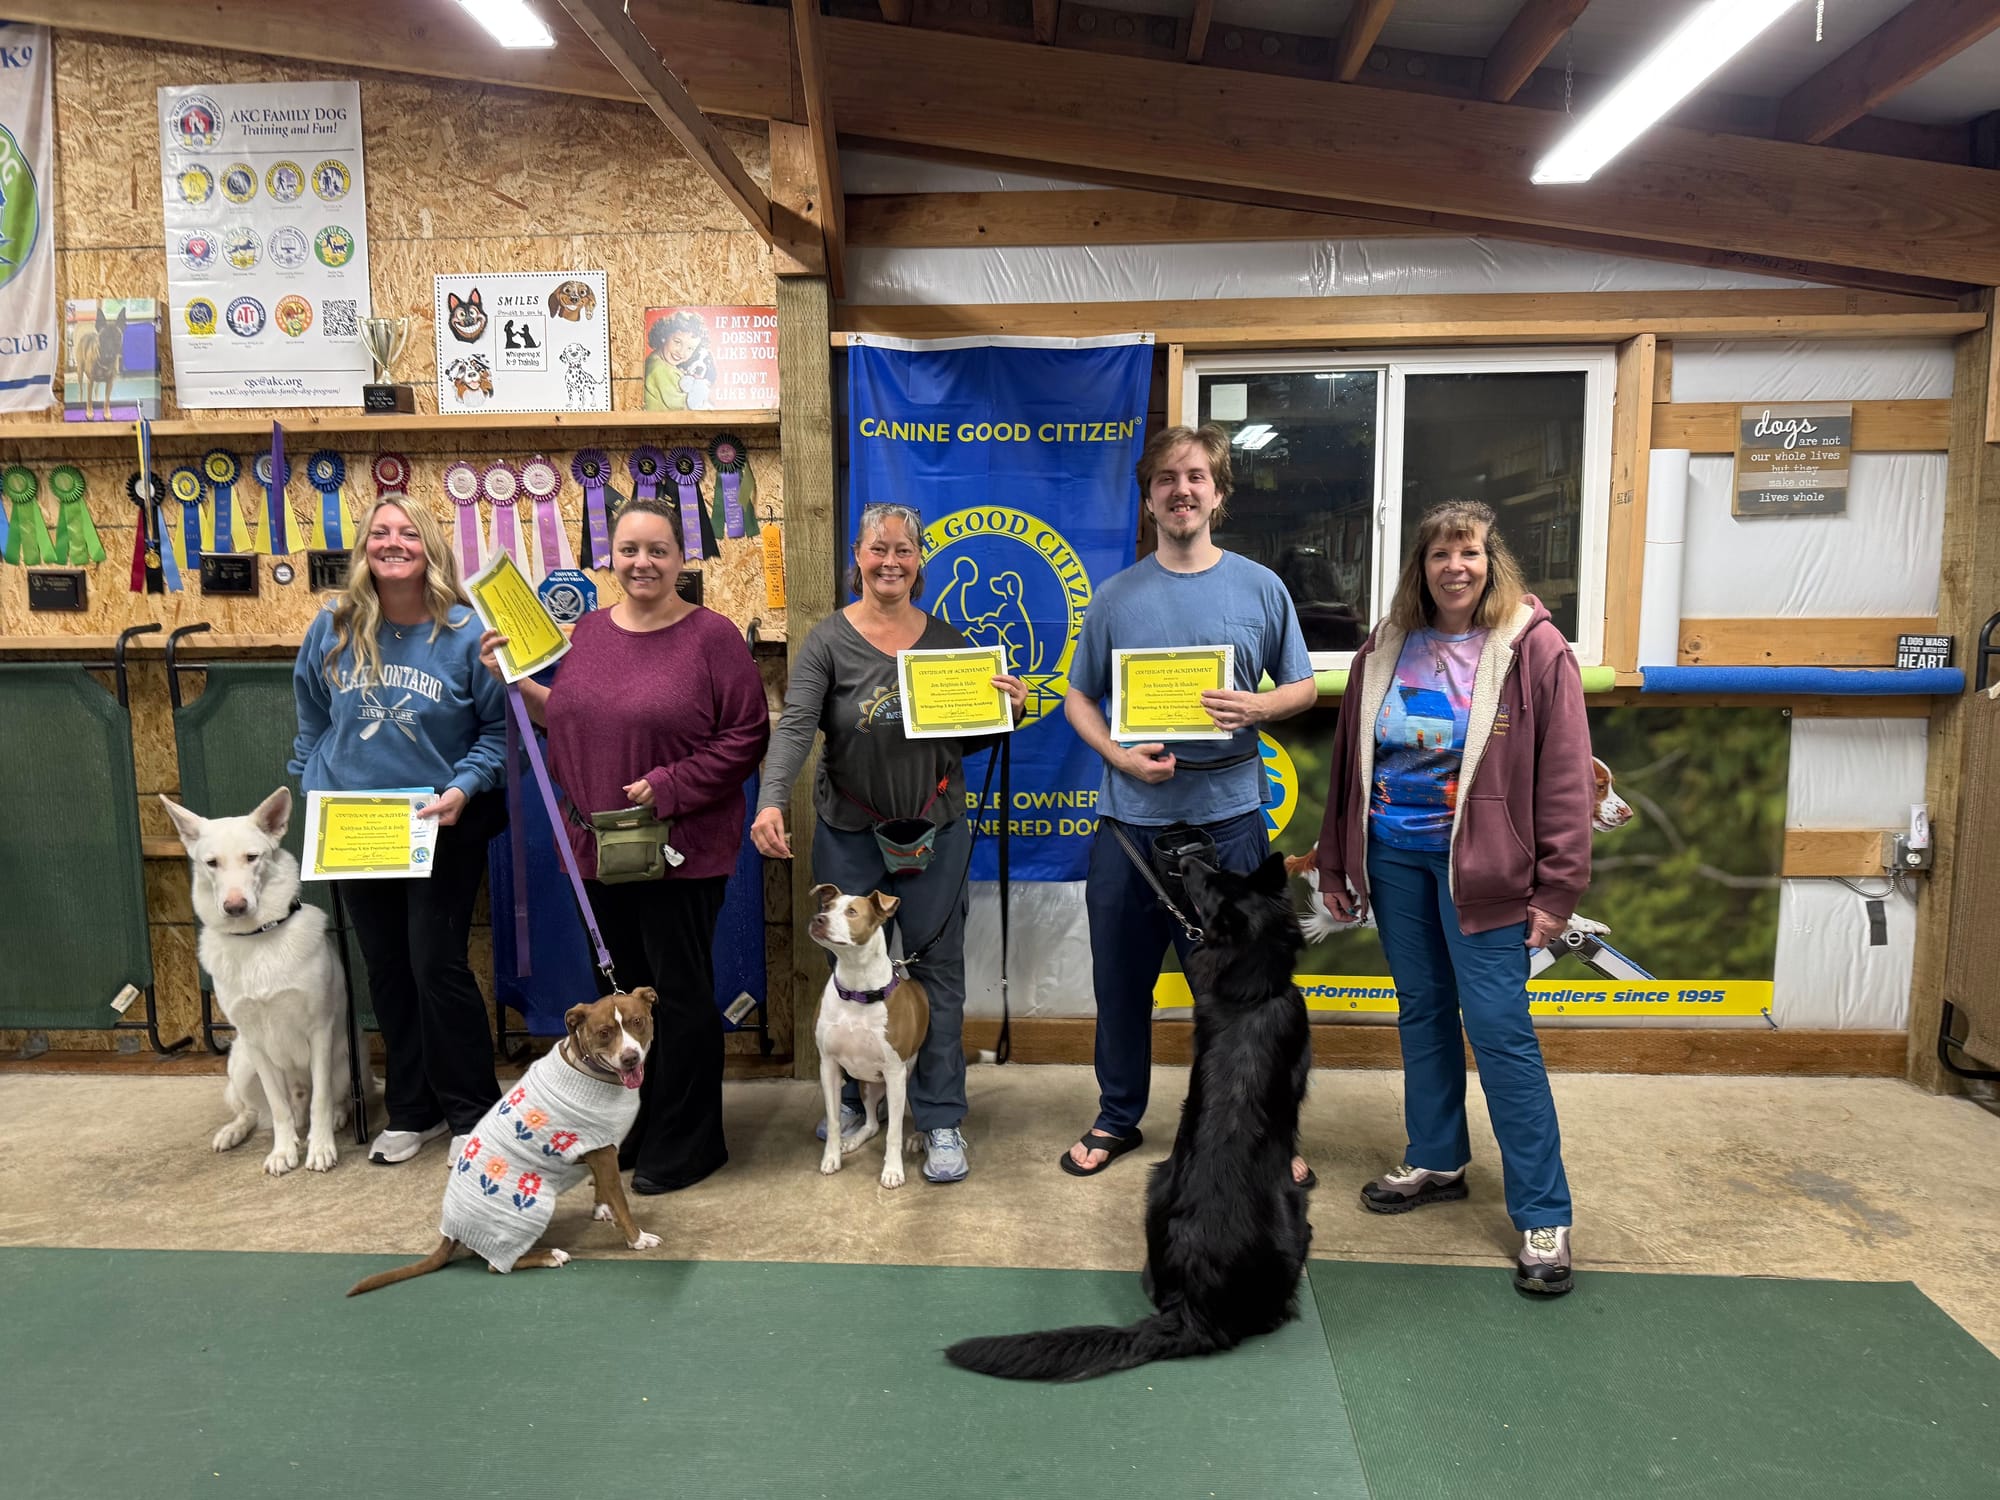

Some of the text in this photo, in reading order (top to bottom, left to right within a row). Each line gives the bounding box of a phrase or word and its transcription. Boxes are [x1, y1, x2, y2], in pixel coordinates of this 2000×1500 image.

[230, 108, 347, 122] AKC FAMILY DOG
[241, 123, 337, 138] Training and Fun!
[497, 296, 539, 306] SMILES
[237, 307, 255, 323] ATT
[715, 315, 778, 328] IF MY DOG
[721, 331, 771, 344] DOESN'T
[717, 347, 777, 360] LIKE YOU.
[518, 358, 540, 366] Training
[724, 372, 767, 384] I DON'T
[716, 388, 776, 400] LIKE YOU.
[860, 417, 950, 442] CANINE
[957, 422, 1031, 442] GOOD
[1754, 410, 1818, 450] dogs
[1798, 436, 1840, 446] are not
[1775, 452, 1806, 461] whole
[1810, 451, 1840, 460] lives
[1771, 464, 1819, 475] but they
[1768, 478, 1794, 487] make
[1759, 492, 1825, 503] lives whole
[944, 510, 1029, 539] GOOD
[1900, 637, 1948, 646] A DOG WAGS
[1898, 653, 1947, 669] HEART
[384, 664, 442, 703] ONTARIO
[362, 708, 413, 720] NEW YORK
[1013, 790, 1099, 810] OWNER
[1613, 989, 1670, 1003] since
[1677, 990, 1725, 1003] 1995
